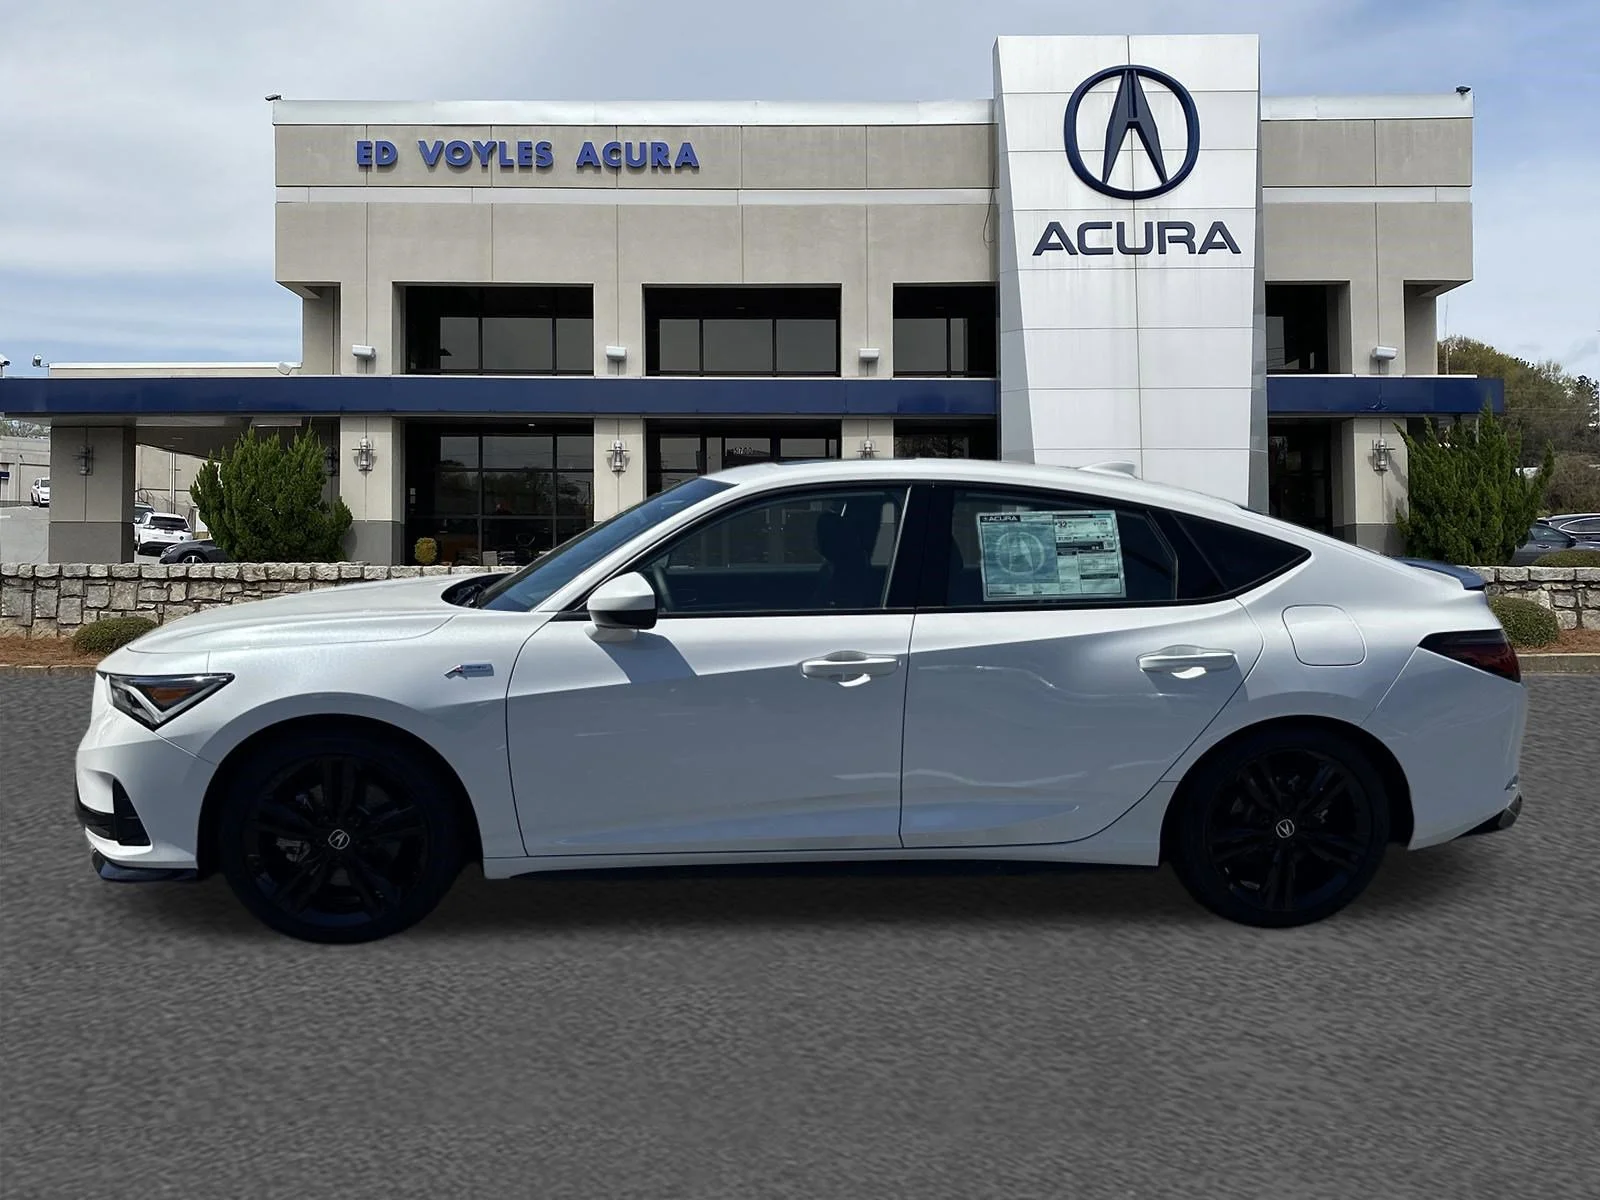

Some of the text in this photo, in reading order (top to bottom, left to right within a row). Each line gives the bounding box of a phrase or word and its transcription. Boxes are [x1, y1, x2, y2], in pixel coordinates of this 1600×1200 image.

[356, 140, 700, 168] ED VOYLES ACURA
[1032, 221, 1242, 256] ACURA
